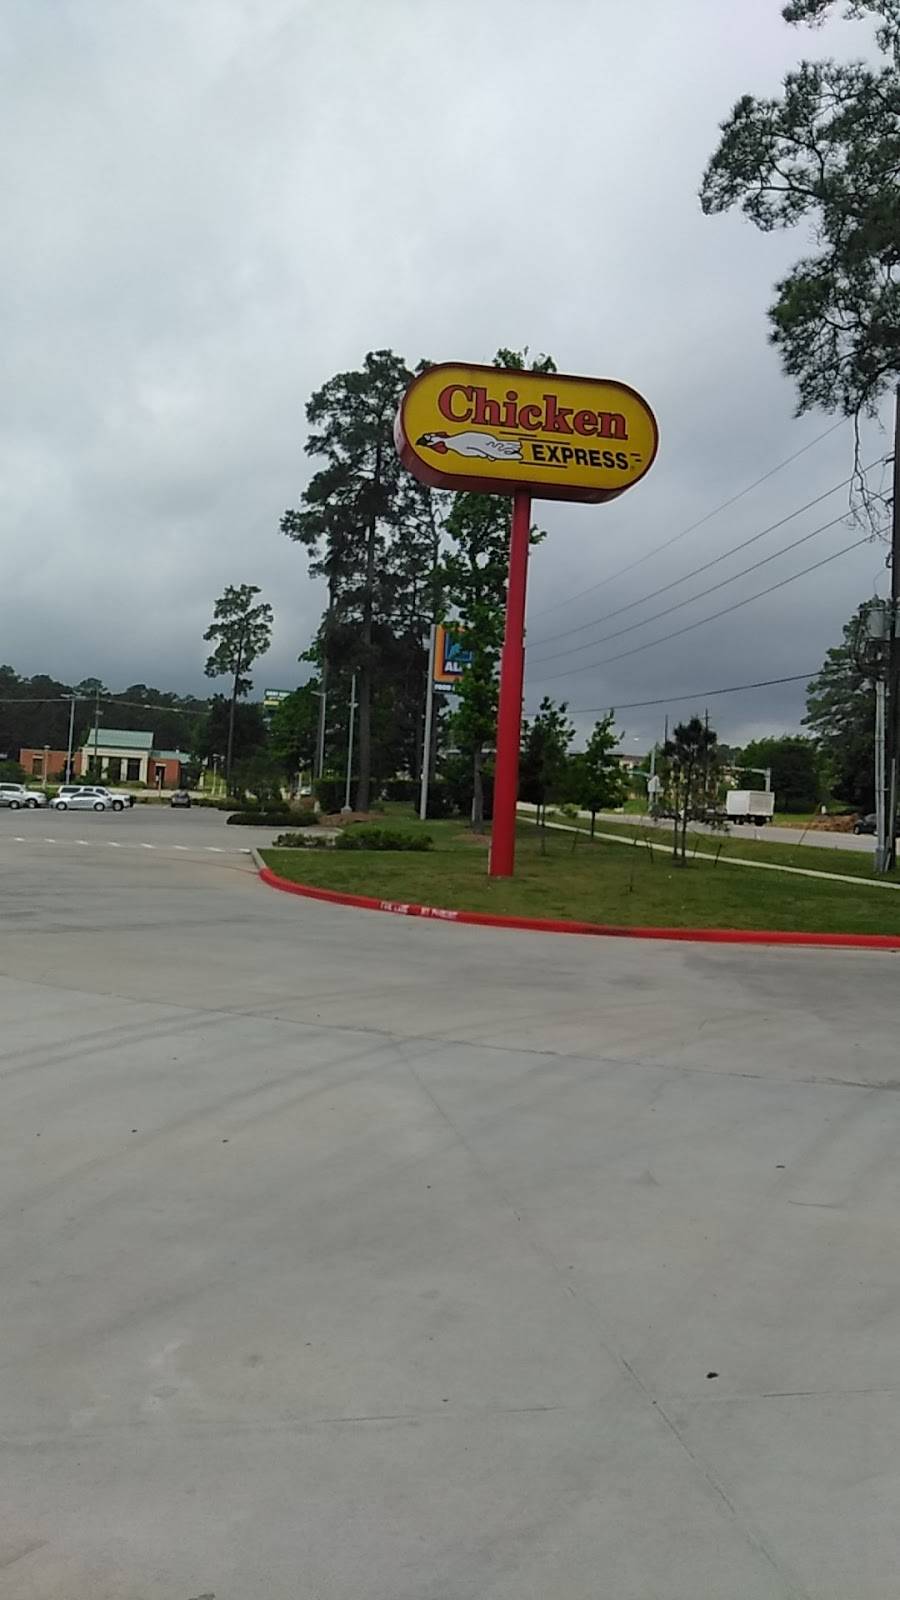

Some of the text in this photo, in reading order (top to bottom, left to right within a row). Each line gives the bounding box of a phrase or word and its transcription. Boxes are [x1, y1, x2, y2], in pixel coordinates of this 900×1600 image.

[438, 384, 628, 440] Chicken
[532, 444, 629, 470] EXPRESS
[444, 661, 469, 672] AL
